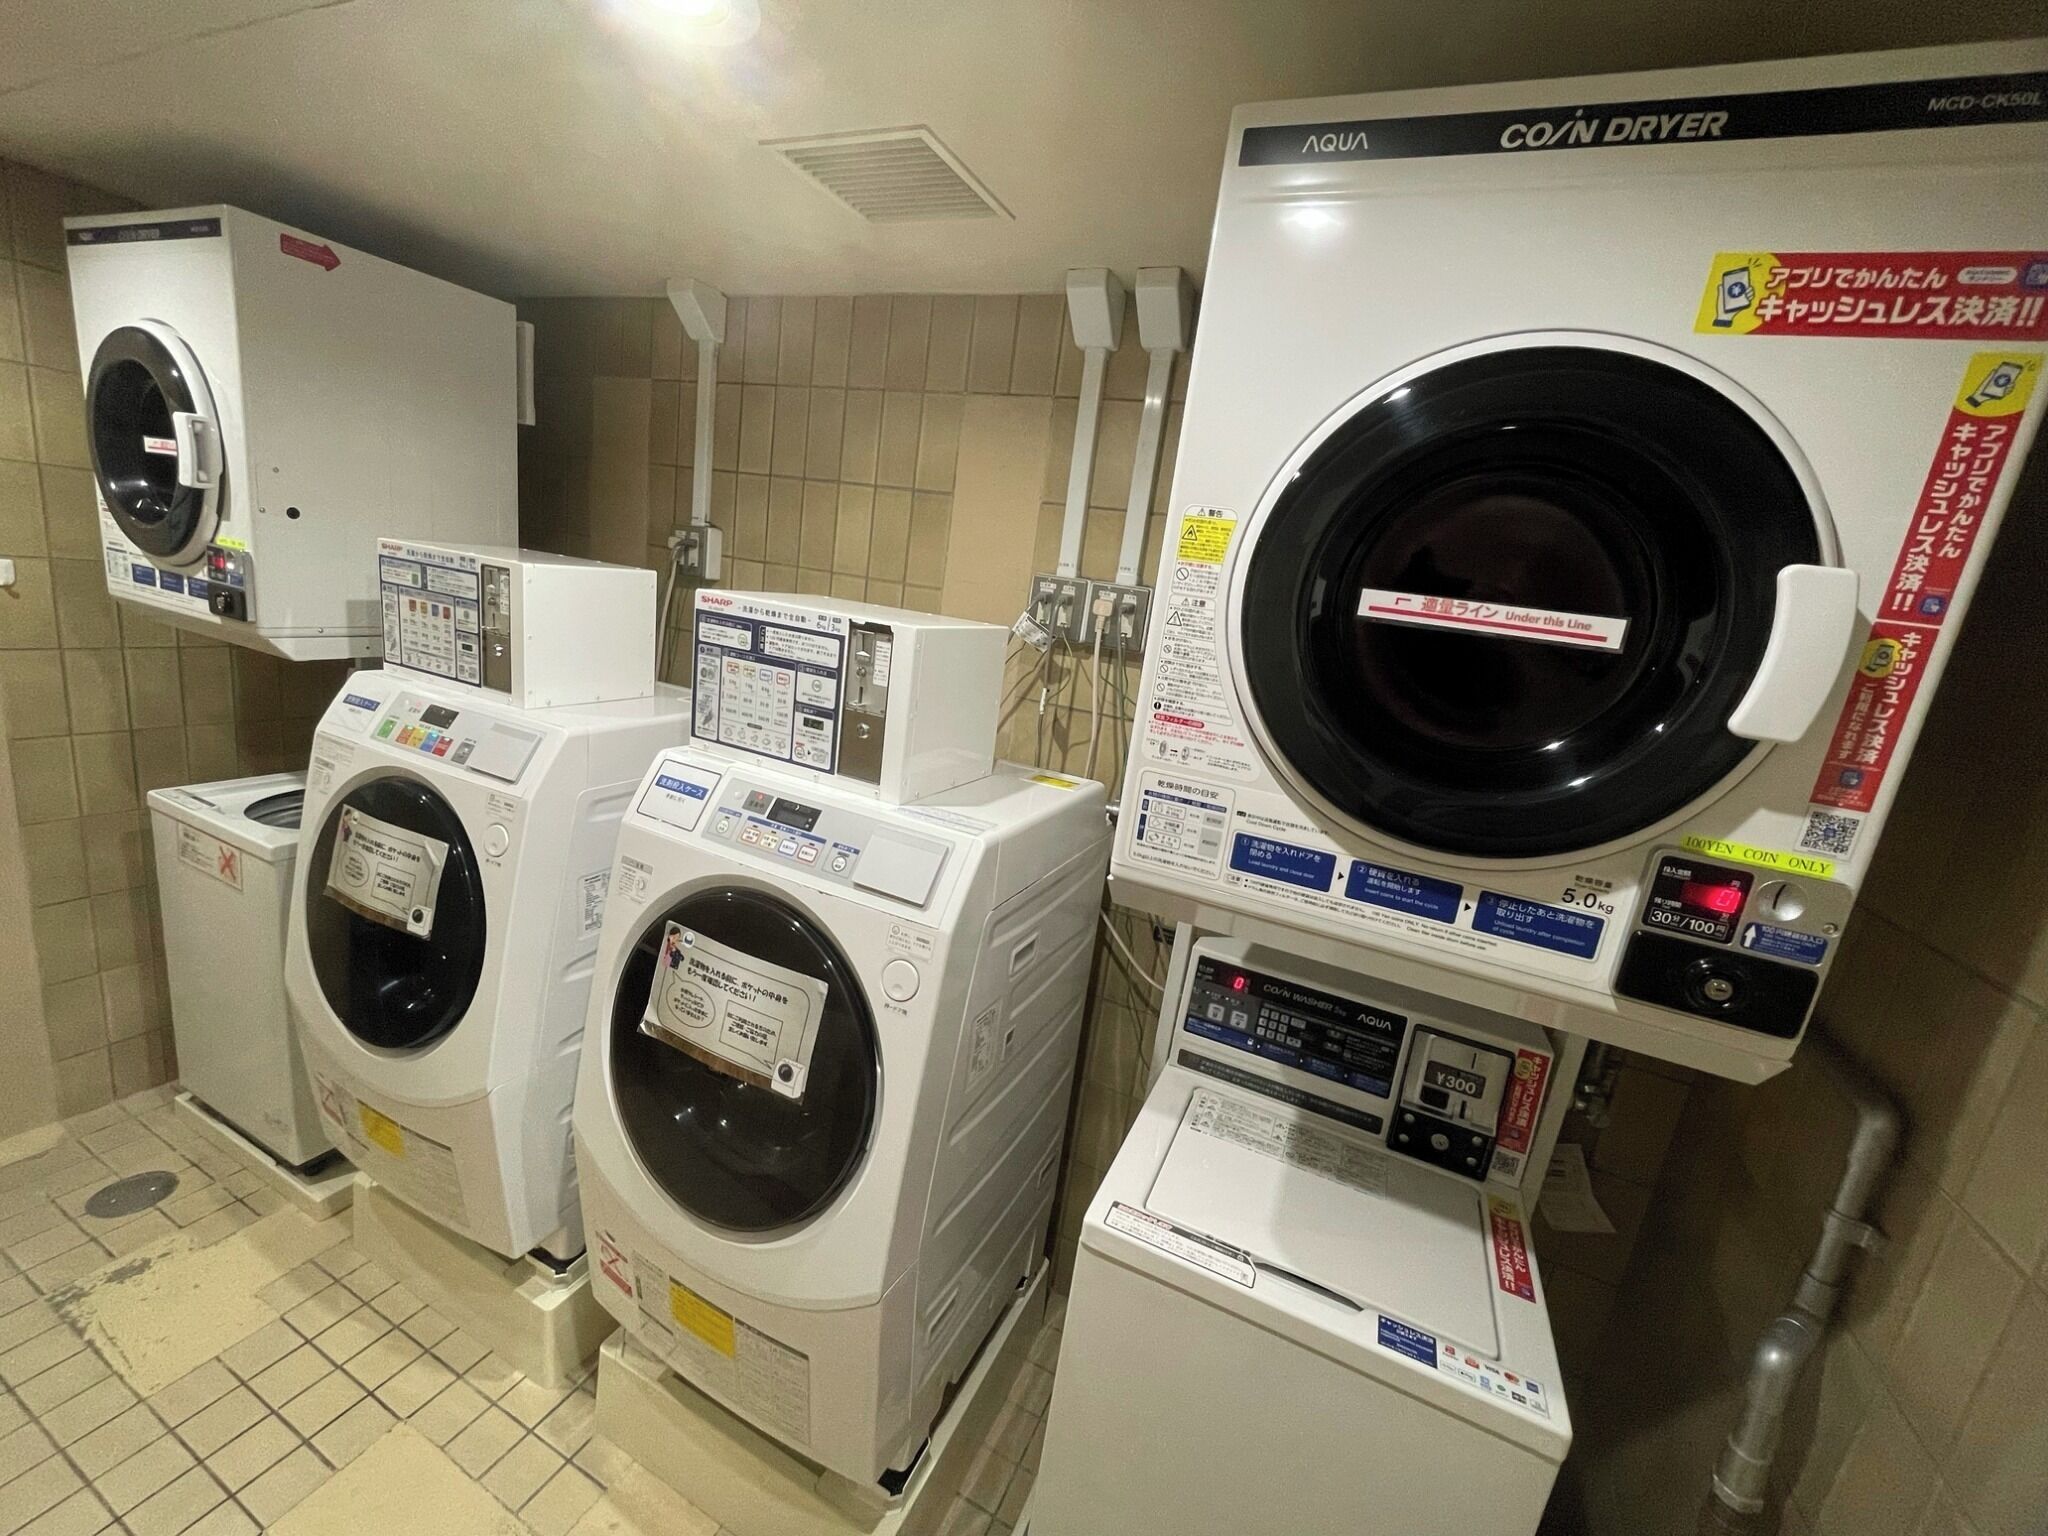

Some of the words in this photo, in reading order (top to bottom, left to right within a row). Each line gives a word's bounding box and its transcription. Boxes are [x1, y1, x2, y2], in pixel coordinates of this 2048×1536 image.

[1602, 111, 1729, 145] DRYER
[1302, 131, 1368, 152] AQUA
[1764, 267, 1949, 290] アプリでかんたん
[1755, 294, 2041, 327] キャッシュレス決済!!
[1937, 424, 2008, 560] アプリでかんたん
[1890, 422, 1978, 612] キャッシュレス決済!!
[700, 595, 733, 607] SHARP
[1421, 595, 1499, 620] 適量ライン
[1505, 610, 1540, 625] Under
[1543, 614, 1564, 628] this
[1567, 619, 1593, 632] Line
[1856, 631, 1922, 765] キャッシュレス決済
[1157, 779, 1219, 800] 乾燥時間の目安
[1251, 840, 1321, 863] 洗濯物を入れドアを
[1685, 835, 1735, 855] 100YEN
[1742, 847, 1779, 865] COIN
[1788, 856, 1833, 875] ONLY
[1368, 867, 1420, 886] 硬貨を入れる
[1561, 887, 1615, 915] 5.0kg
[1496, 907, 1534, 924] 取り出す
[1498, 899, 1596, 929] 停止したあと洗濯物を
[1232, 976, 1245, 990] 0
[1356, 1013, 1392, 1031] AQUA
[1435, 1071, 1477, 1096] ¥300
